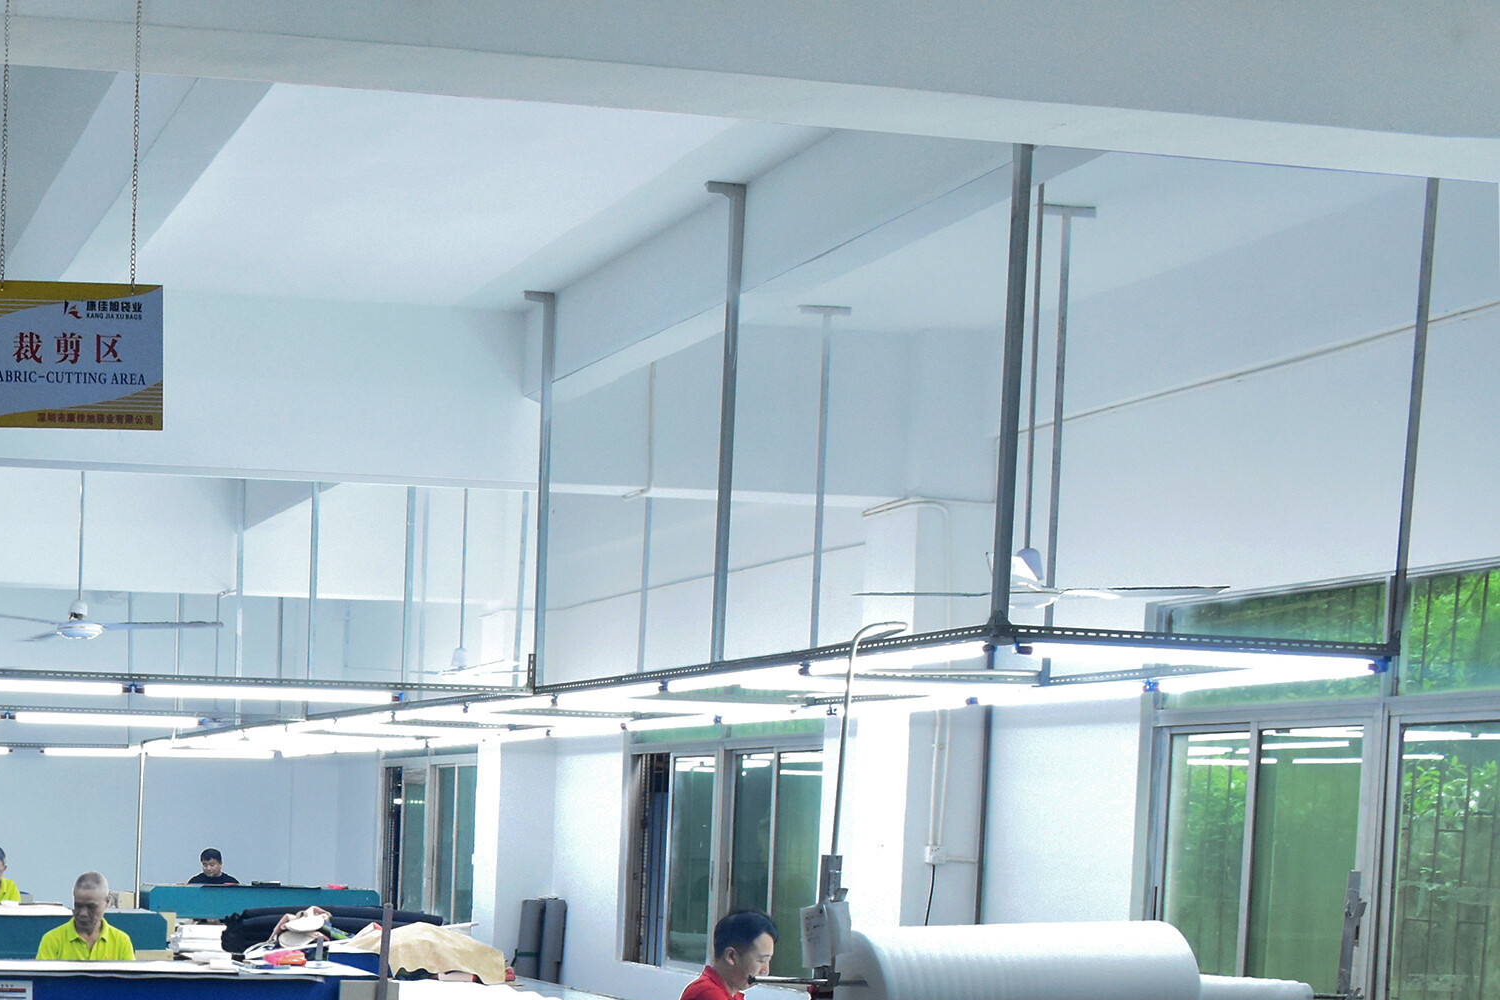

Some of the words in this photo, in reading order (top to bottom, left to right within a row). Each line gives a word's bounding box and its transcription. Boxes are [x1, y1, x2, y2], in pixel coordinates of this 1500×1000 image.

[86, 312, 104, 320] KANG
[125, 313, 143, 321] BAGS
[12, 332, 122, 364] 裁剪区
[111, 372, 146, 386] AREA
